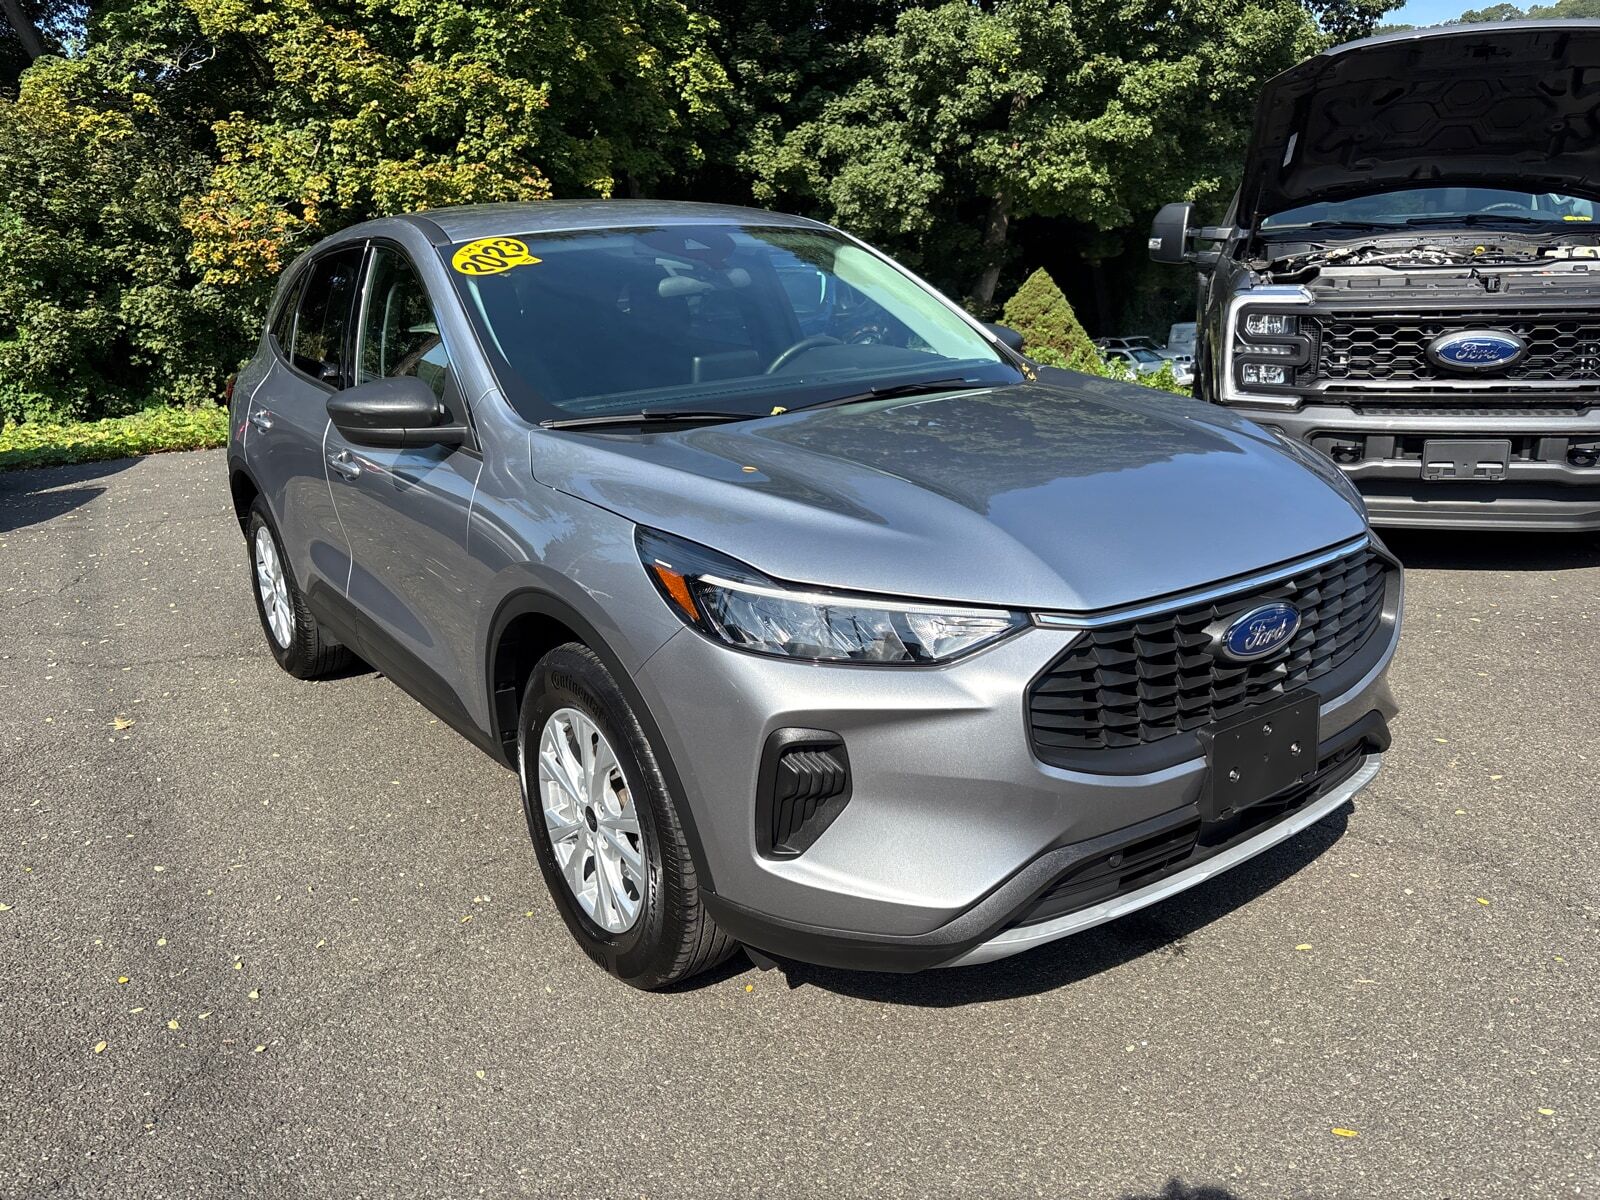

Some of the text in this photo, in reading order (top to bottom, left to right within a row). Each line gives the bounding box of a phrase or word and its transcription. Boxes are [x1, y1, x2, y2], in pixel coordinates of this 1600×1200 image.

[461, 240, 525, 273] 2023
[1455, 342, 1502, 360] Ford
[1244, 616, 1288, 650] Ford
